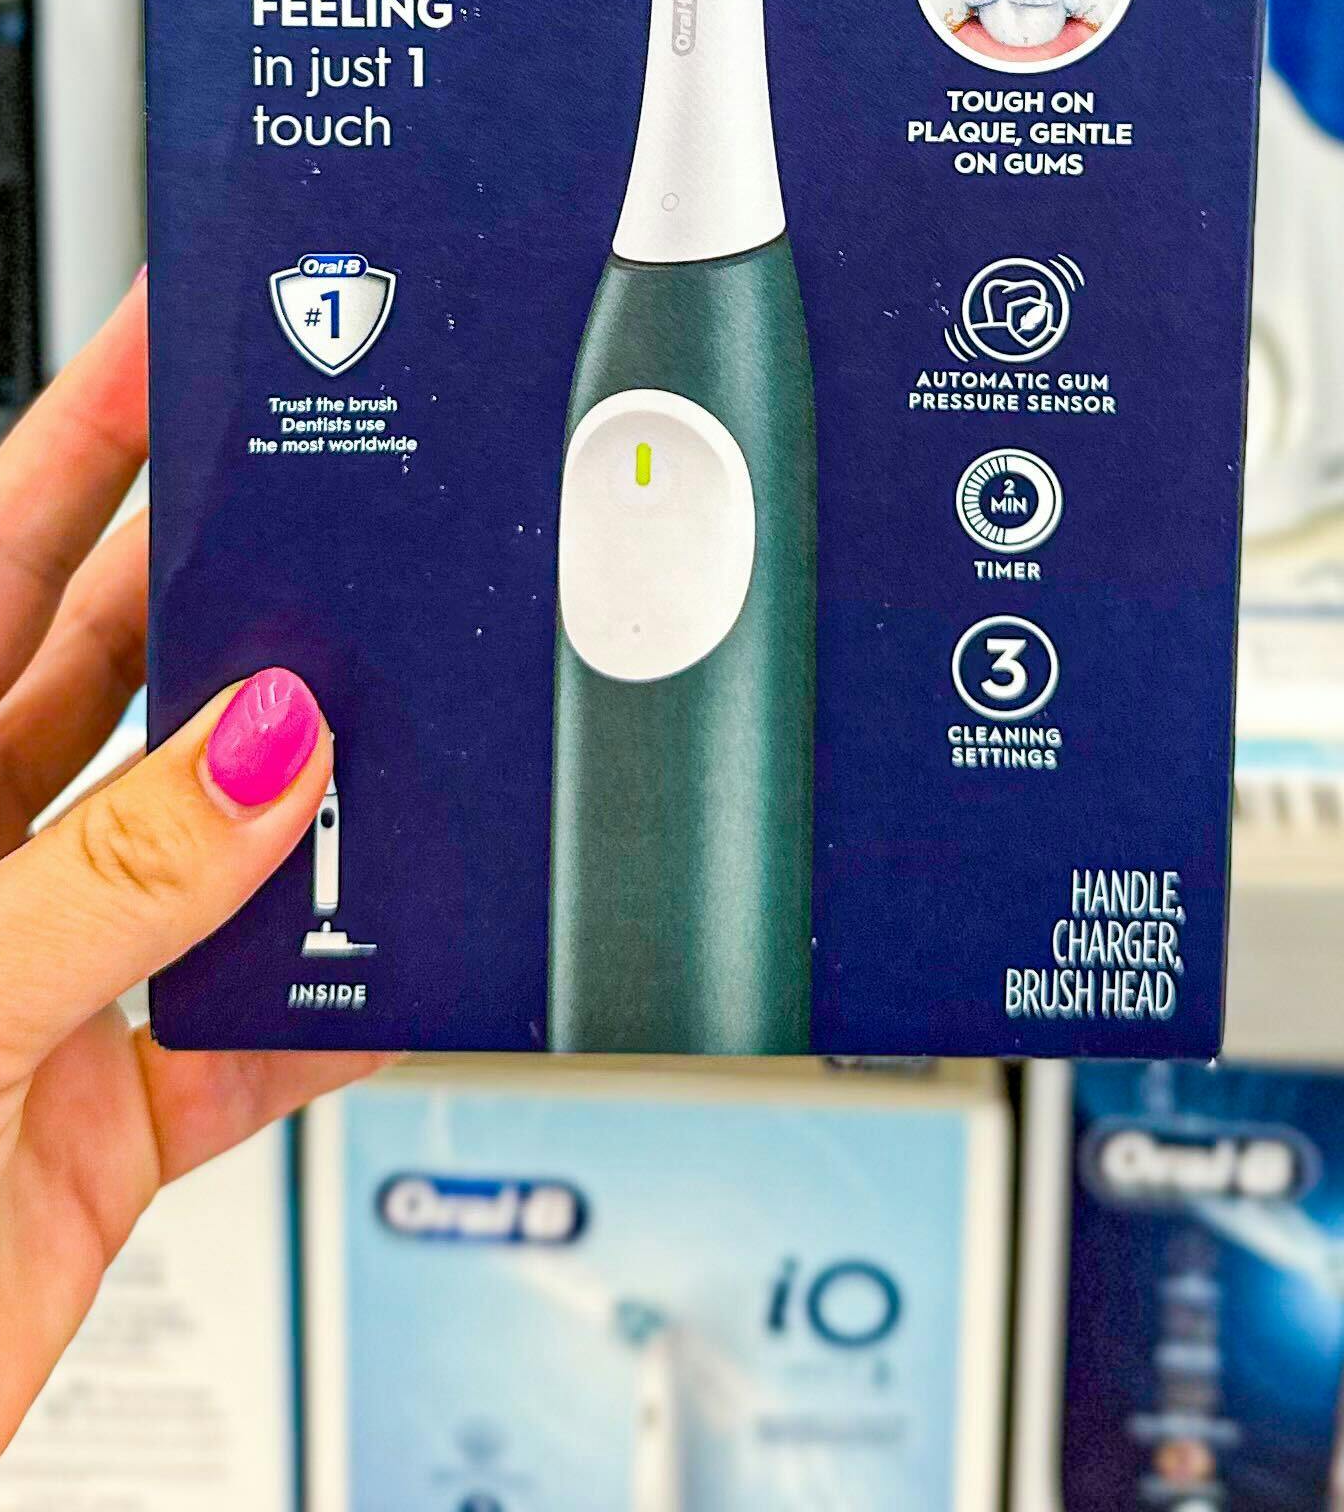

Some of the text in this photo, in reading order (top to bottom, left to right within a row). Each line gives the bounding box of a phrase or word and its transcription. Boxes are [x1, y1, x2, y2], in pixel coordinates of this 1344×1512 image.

[253, 45, 424, 98] in just 1
[946, 90, 1094, 114] TOUGH ON
[253, 104, 391, 147] touch
[907, 121, 1134, 148] PLAQUE, GENTLE
[954, 152, 1084, 176] ON GUMS
[303, 258, 362, 276] Oral-B
[304, 289, 341, 339] #1
[916, 371, 1110, 392] AUTOMATIC GUM
[268, 396, 398, 414] Trust the brush
[908, 392, 1117, 415] PRESSURE SENSOR
[281, 417, 387, 433] Dentists use
[248, 435, 419, 454] the most worldwide
[1003, 478, 1016, 495] 2
[990, 496, 1029, 515] MIN
[973, 560, 1042, 581] TIMER
[981, 638, 1028, 701] 3
[947, 725, 1063, 748] CLEANING
[951, 746, 1059, 770] SETTINGS
[1072, 868, 1186, 925] HANDLE,
[1052, 919, 1185, 975] CHARGER,
[288, 983, 367, 1008] INSIDE
[1006, 967, 1176, 1021] BRUSH HEAD
